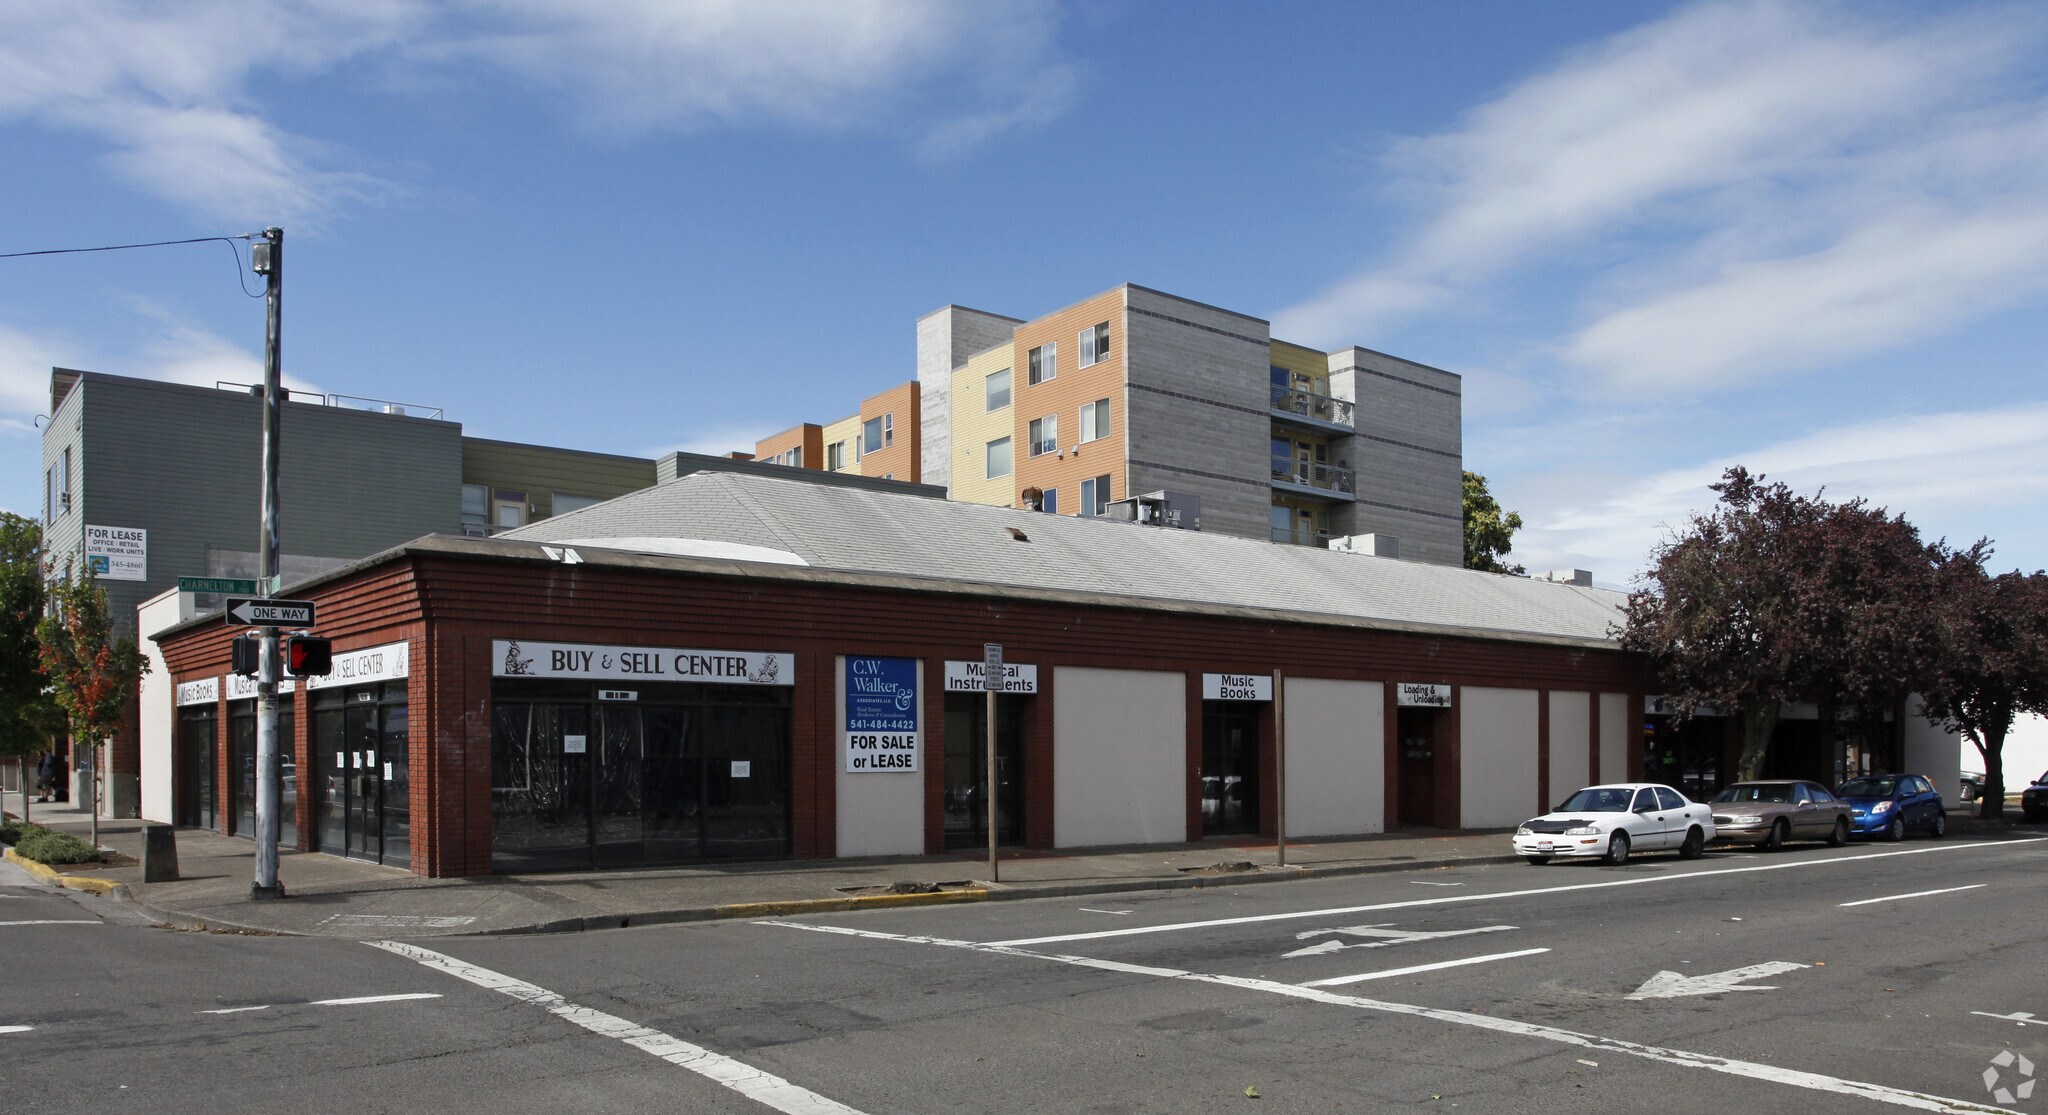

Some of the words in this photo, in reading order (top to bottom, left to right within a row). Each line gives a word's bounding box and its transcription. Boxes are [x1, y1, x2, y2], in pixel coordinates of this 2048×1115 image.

[88, 529, 108, 538] FOR
[111, 530, 143, 541] LEASE
[111, 561, 143, 569] 345-4860
[180, 579, 235, 592] CHARNELTON
[253, 607, 277, 619] ONE
[281, 608, 306, 620] WAY
[342, 658, 356, 678] SELL
[358, 654, 384, 676] CENTER
[550, 650, 594, 672] BUY
[601, 654, 613, 670] &
[620, 652, 665, 675] SELL
[674, 654, 748, 677] CENTER
[853, 659, 885, 675] C.W.
[966, 663, 1019, 677] Mucal
[950, 677, 1033, 691] Instrents
[1221, 674, 1255, 687] Music
[196, 683, 213, 700] Books
[854, 677, 899, 693] Walker
[895, 688, 914, 711] &
[1220, 687, 1256, 699] Books
[1404, 683, 1429, 696] Loading
[1430, 684, 1435, 694] &
[1413, 694, 1444, 706] Unloading
[850, 719, 914, 729] 541-484-4422
[851, 735, 877, 749] FOR
[881, 735, 914, 750] SALE
[853, 757, 867, 768] or
[870, 754, 912, 768] LEASE
